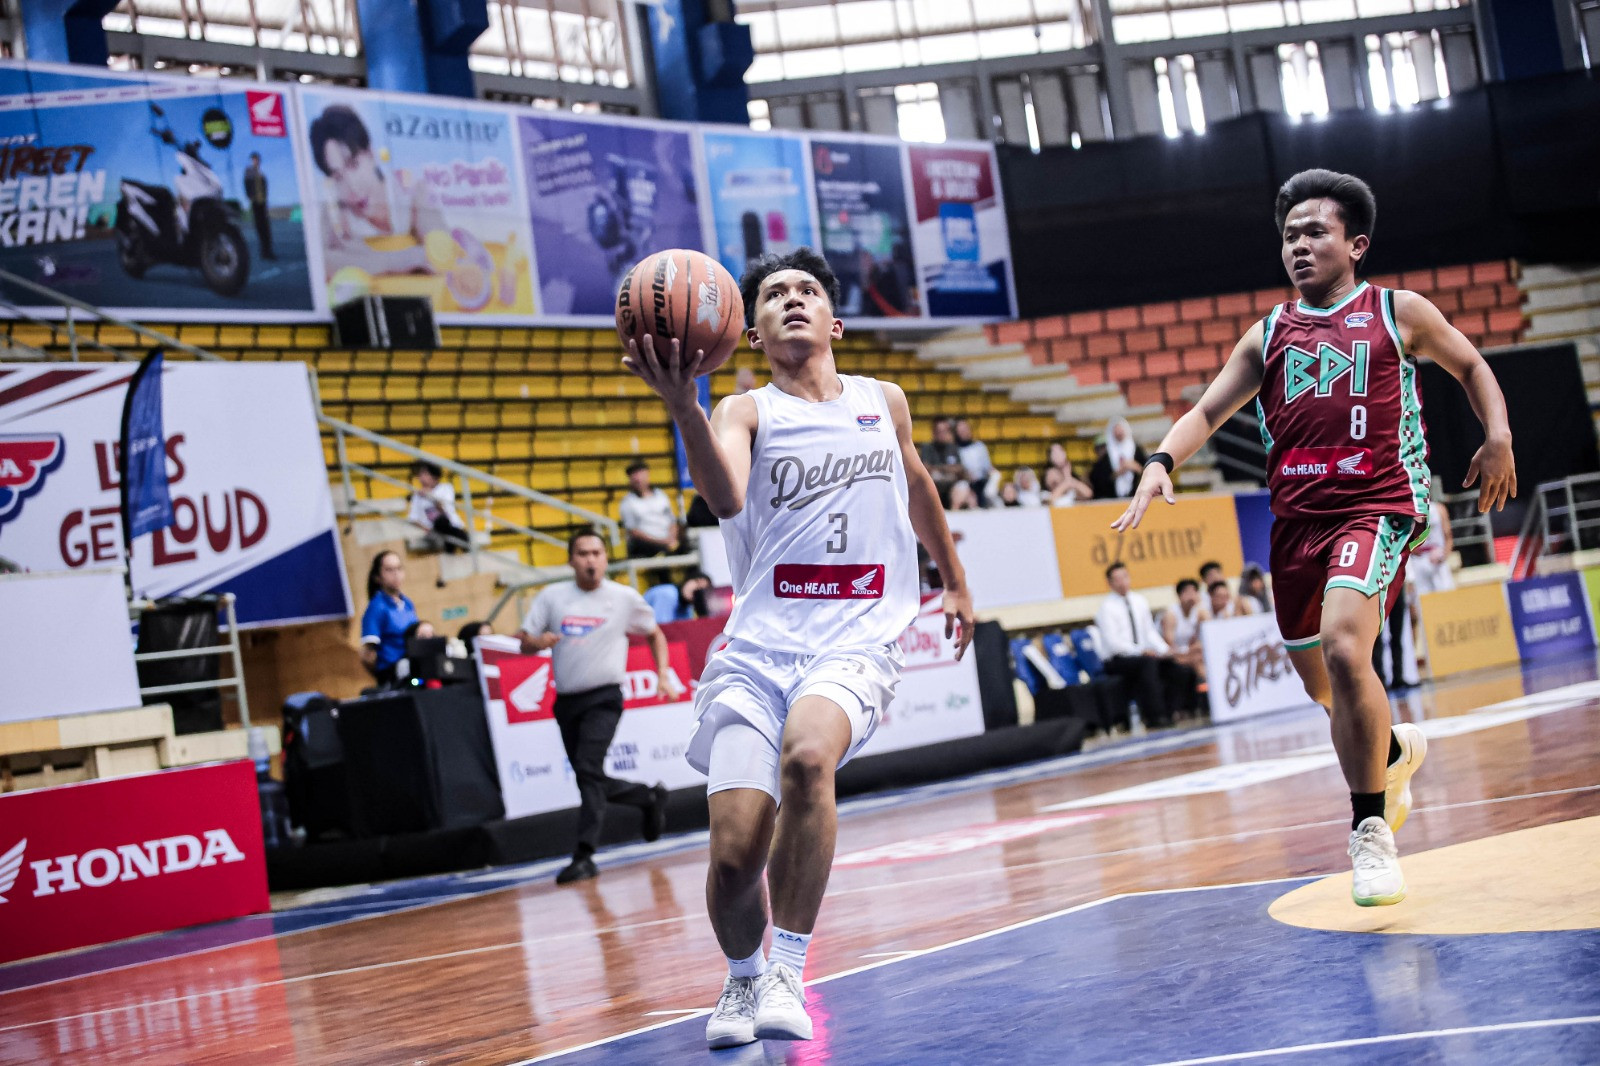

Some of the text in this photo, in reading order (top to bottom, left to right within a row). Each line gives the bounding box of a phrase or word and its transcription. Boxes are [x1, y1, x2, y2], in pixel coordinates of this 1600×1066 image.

[1284, 340, 1370, 404] BPI
[1350, 405, 1367, 440] 8
[770, 449, 894, 509] Delapan
[1282, 465, 1296, 476] One
[826, 512, 848, 553] 3
[1338, 541, 1359, 568] 8
[780, 580, 802, 594] One
[30, 829, 245, 897] HONDA
